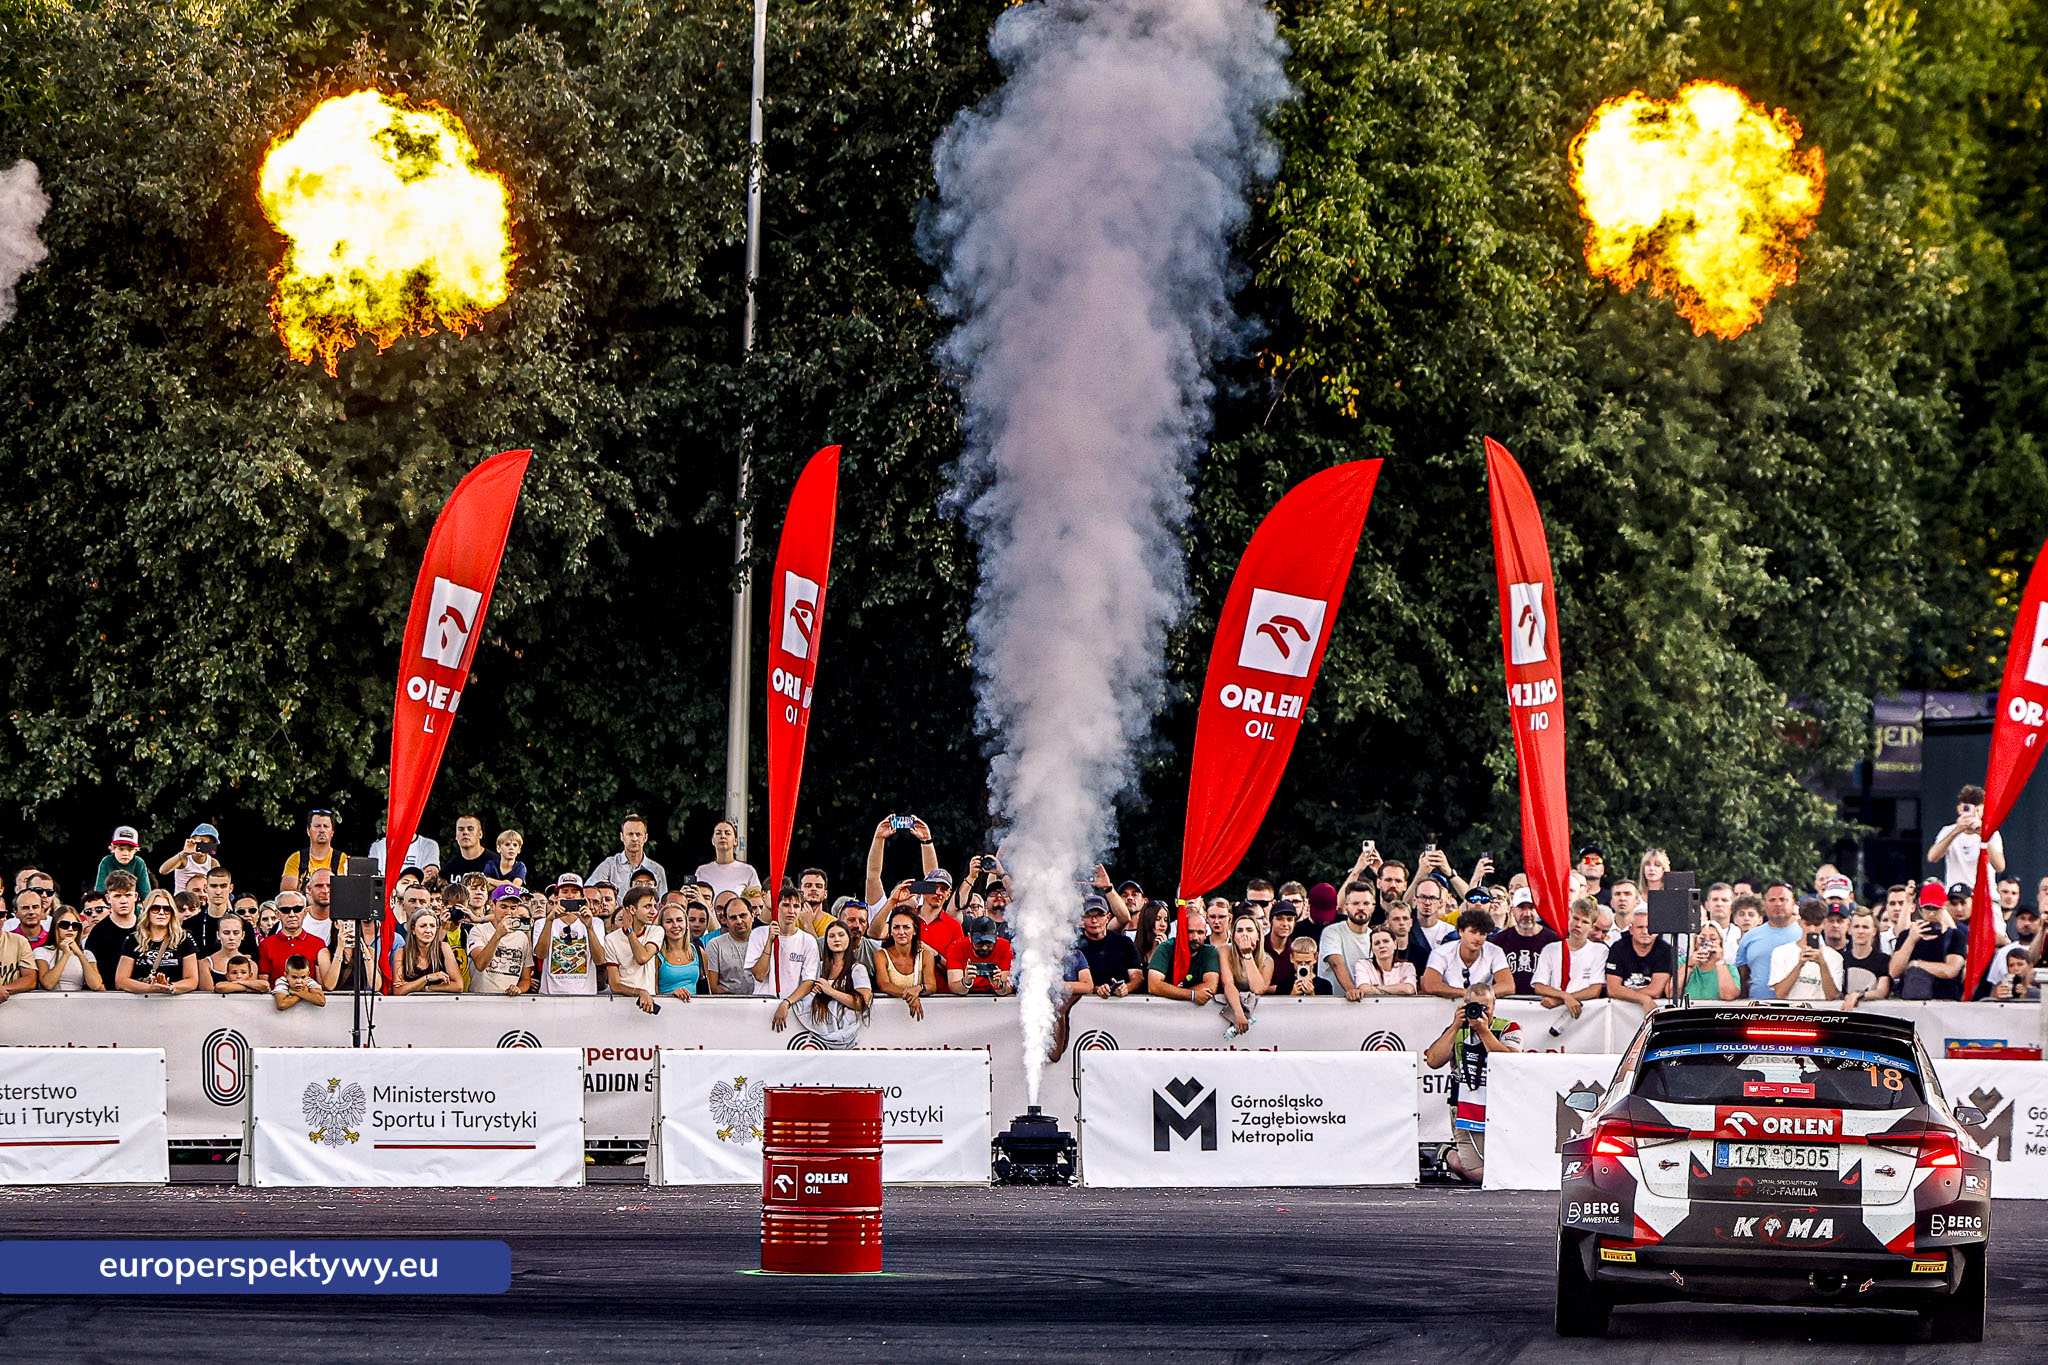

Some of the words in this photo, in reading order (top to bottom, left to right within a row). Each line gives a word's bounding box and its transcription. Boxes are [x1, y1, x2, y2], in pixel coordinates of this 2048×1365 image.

[1220, 683, 1303, 719] ORLEN
[2008, 696, 2048, 727] OR
[1245, 719, 1276, 741] OIL
[1715, 1044, 1758, 1052] FOLLOW
[1864, 1065, 1904, 1091] 18
[373, 1085, 496, 1103] Ministerstwo
[1231, 1094, 1324, 1111] Górnośląsko
[22, 1107, 27, 1124] i
[32, 1106, 119, 1128] Turystyki
[372, 1110, 435, 1131] Sportu
[441, 1110, 446, 1128] i
[451, 1110, 537, 1132] Turystyki
[881, 1105, 944, 1127] rystyki
[1231, 1111, 1346, 1129] -Zagłębiowska
[2028, 1106, 2048, 1121] Gó
[1762, 1117, 1834, 1136] ORLEN
[1231, 1129, 1314, 1146] Metropolia
[1735, 1146, 1768, 1166] 14R
[1783, 1148, 1830, 1168] 0505
[2025, 1143, 2048, 1156] Me
[804, 1172, 849, 1184] ORLEN
[804, 1186, 822, 1195] OIL
[1757, 1186, 1819, 1197] PRO-FAMILIA
[1583, 1202, 1620, 1215] BERG
[1581, 1216, 1620, 1224] INWESTYCJE
[1947, 1215, 1982, 1229] BERG
[1947, 1230, 1983, 1238] INWESTYCJE
[1603, 1250, 1633, 1261] PIRELLI
[1915, 1263, 1945, 1272] PIRELLI
